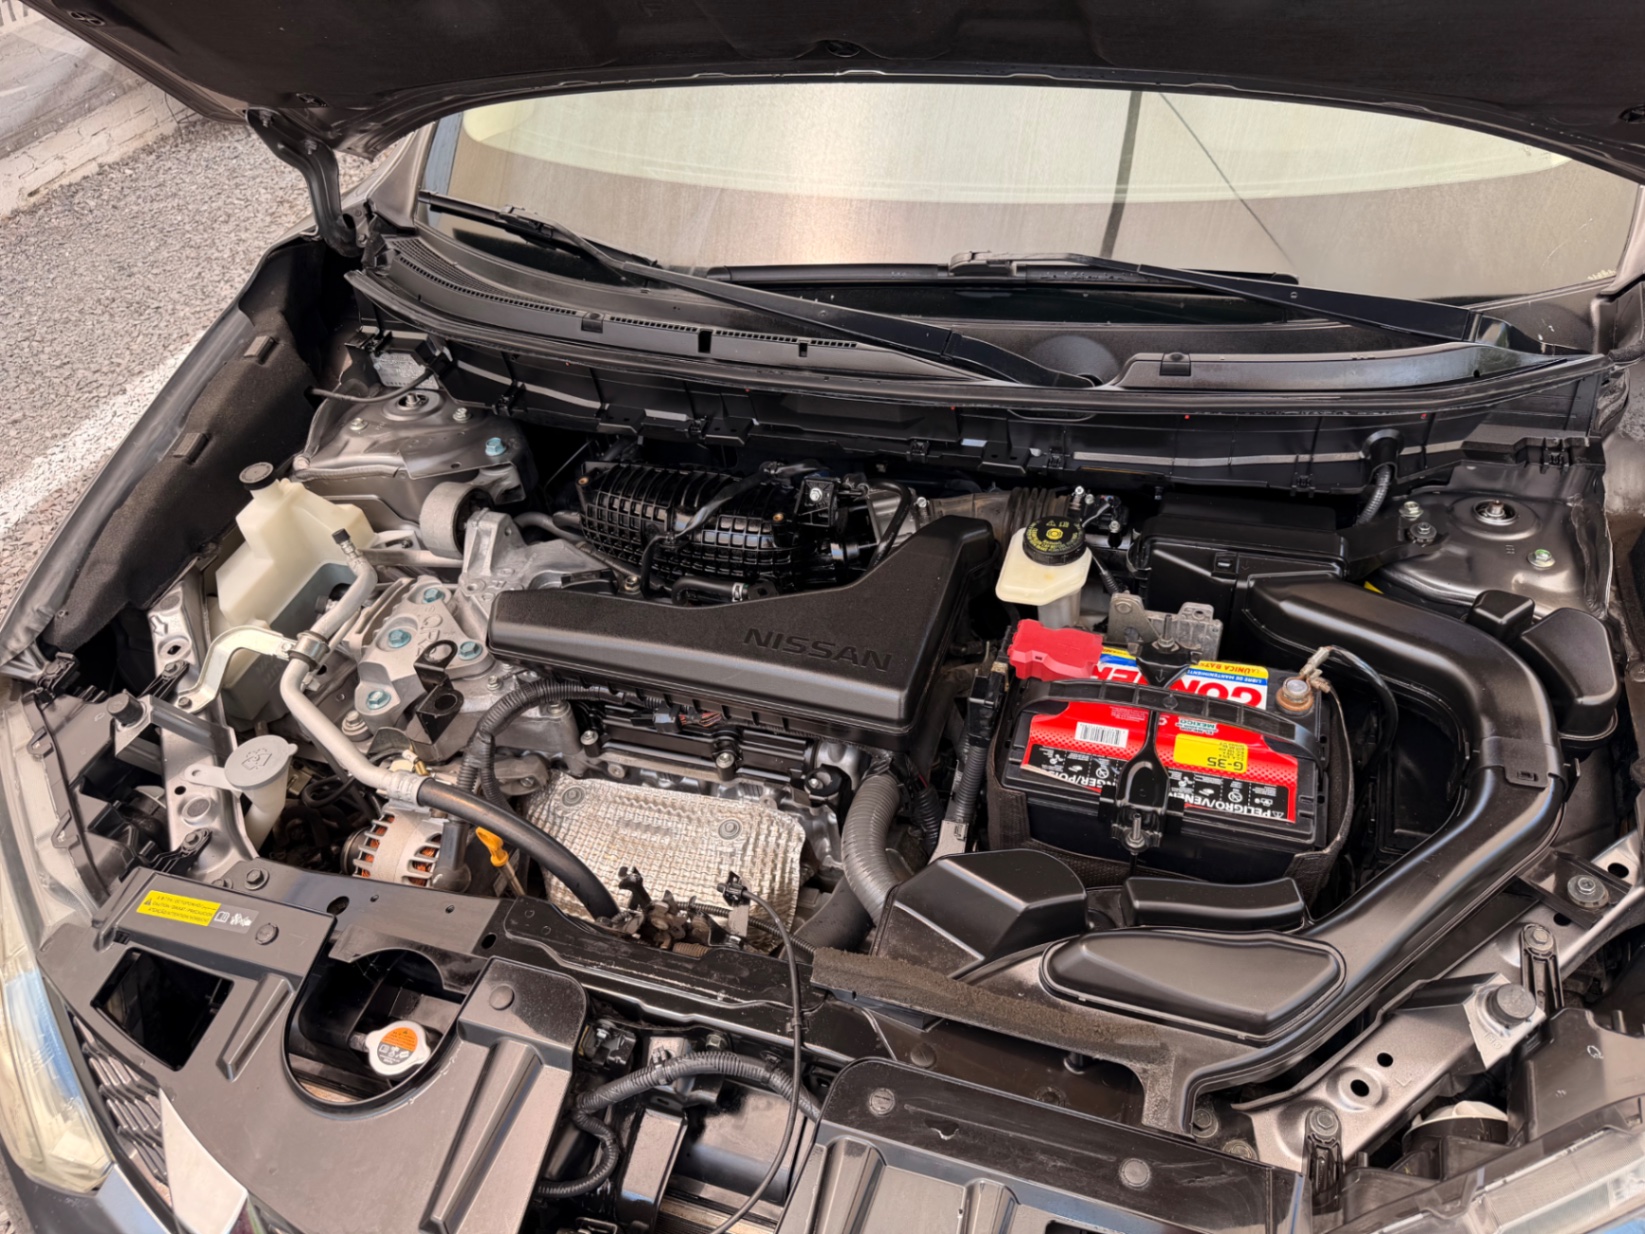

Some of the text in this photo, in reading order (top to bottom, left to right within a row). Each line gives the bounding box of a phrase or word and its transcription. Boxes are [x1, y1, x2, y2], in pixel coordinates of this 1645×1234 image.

[743, 628, 893, 672] NISSAN
[1199, 662, 1222, 670] BAT
[1244, 676, 1262, 684] LIBRE
[1207, 756, 1243, 771] G-35
[1168, 792, 1271, 817] PELIGRO/VENEN
